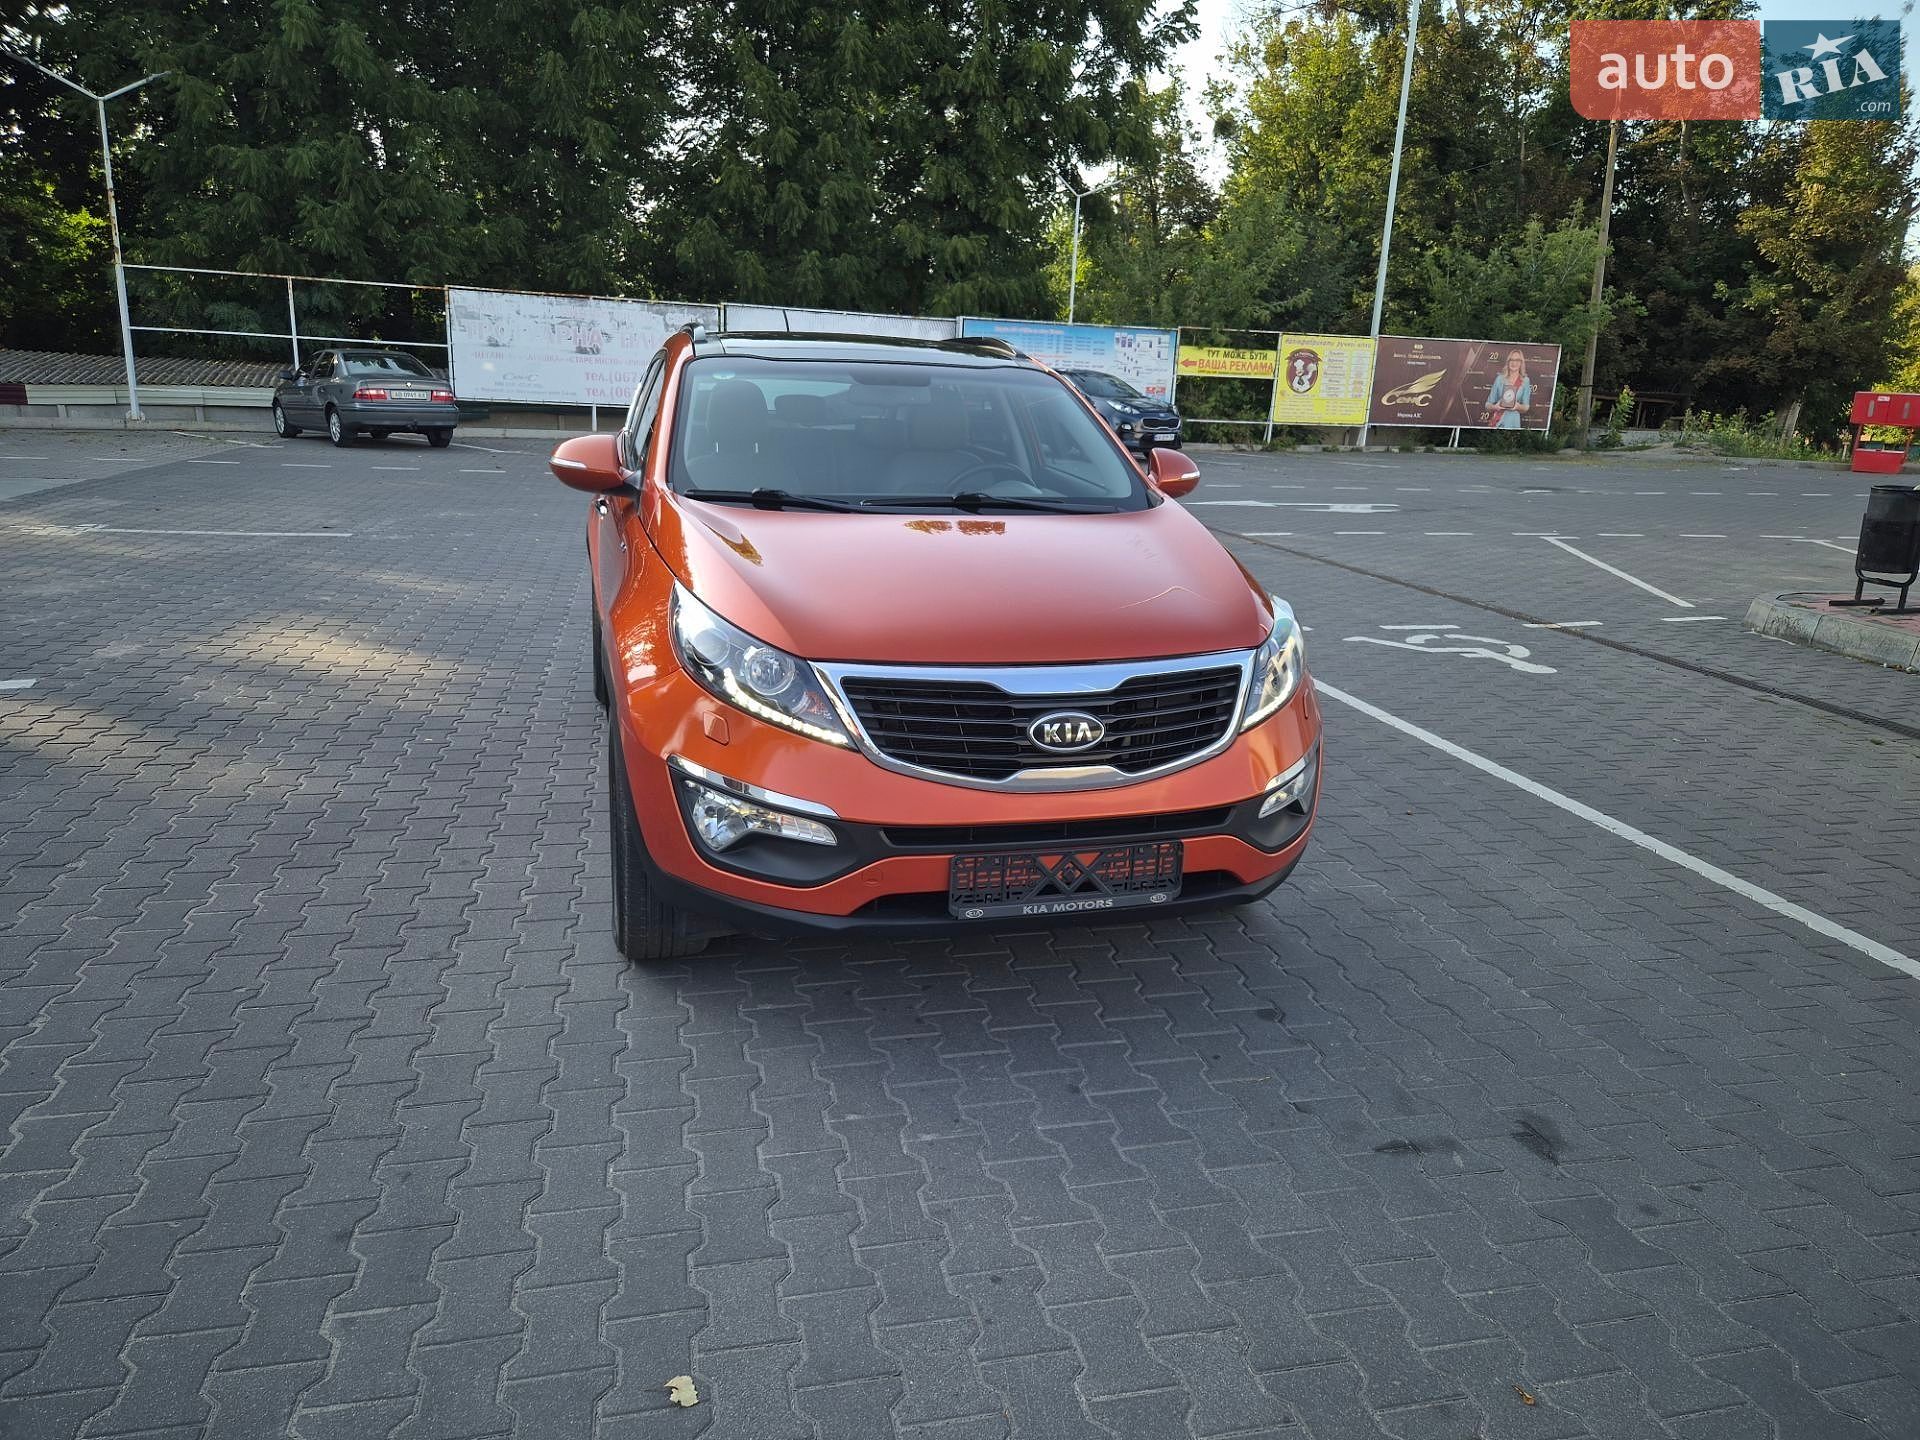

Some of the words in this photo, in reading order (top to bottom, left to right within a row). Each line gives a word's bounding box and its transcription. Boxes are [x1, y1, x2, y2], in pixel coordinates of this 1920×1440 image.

[1206, 350, 1220, 359] ТУТ
[1222, 351, 1246, 360] МОЖЕ
[1249, 352, 1268, 361] БУТИ
[1198, 358, 1227, 370] ВАША
[1229, 360, 1274, 373] РЕКЛАМА
[1043, 722, 1093, 743] KIA
[1022, 902, 1048, 915] KIA
[1052, 899, 1113, 913] MOTORS
